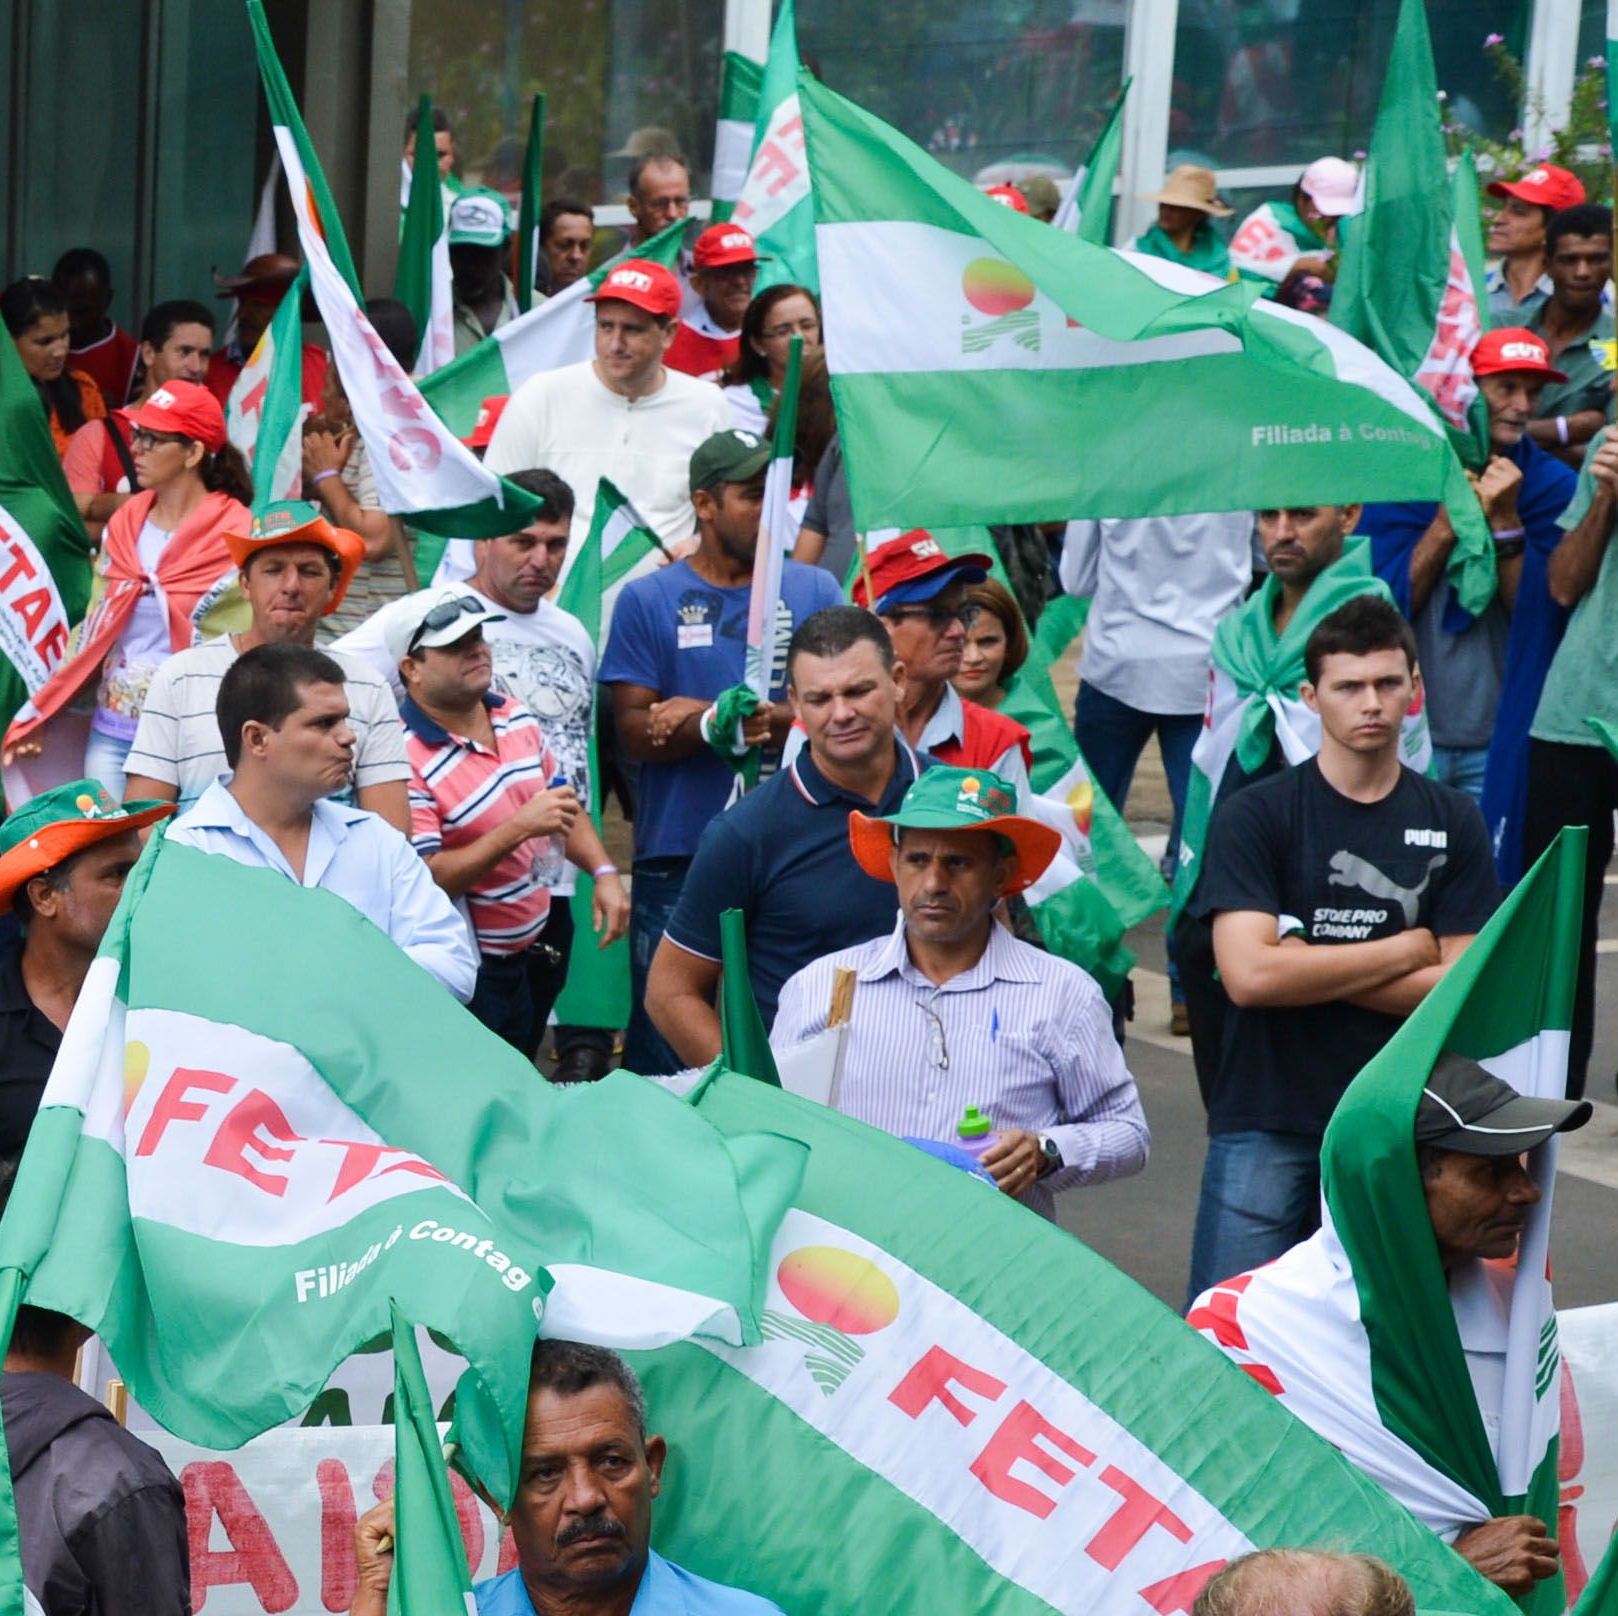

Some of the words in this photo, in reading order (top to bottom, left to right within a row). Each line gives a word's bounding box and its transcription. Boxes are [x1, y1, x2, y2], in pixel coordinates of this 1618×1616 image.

[1500, 342, 1544, 360] CUT
[1251, 424, 1332, 447] Filiada
[408, 1218, 532, 1292] Contag
